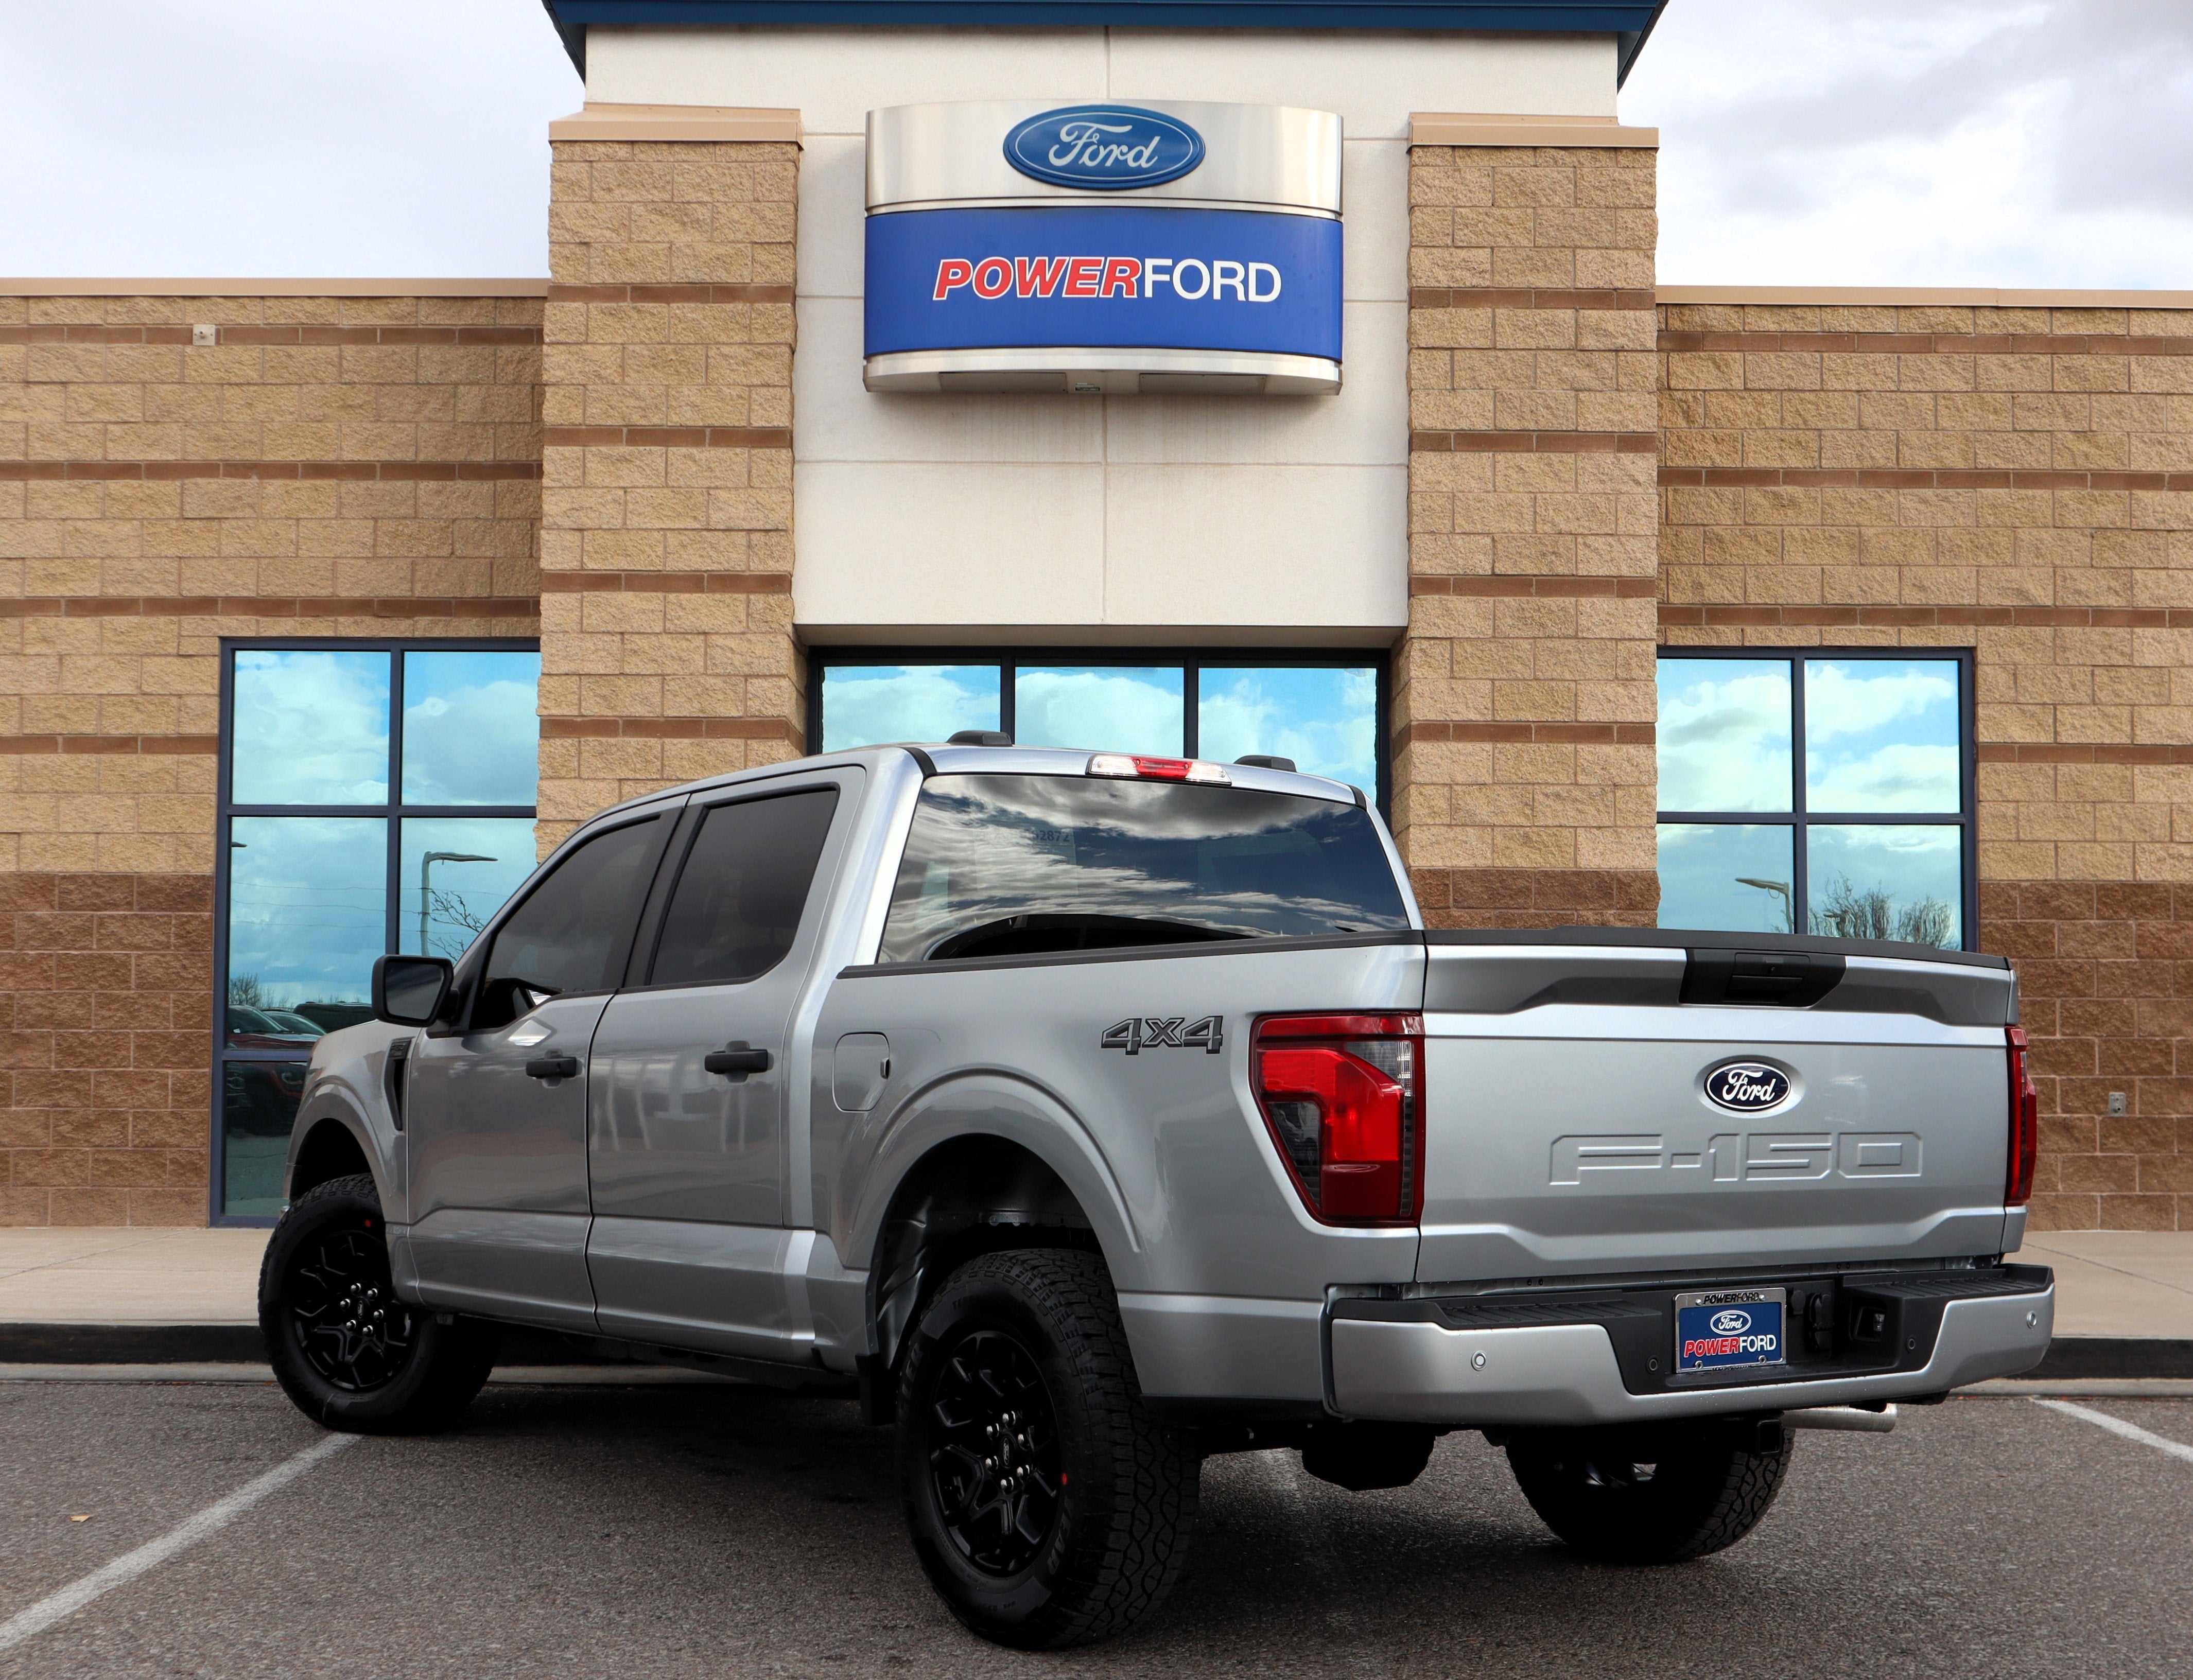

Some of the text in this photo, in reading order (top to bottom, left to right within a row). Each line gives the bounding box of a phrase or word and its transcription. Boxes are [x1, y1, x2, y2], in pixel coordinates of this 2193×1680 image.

[1049, 122, 1161, 168] Ford
[933, 256, 1282, 302] POWERFORD
[1722, 1070, 1776, 1101] Ford
[1549, 1132, 1923, 1185] F-150
[1703, 1292, 1759, 1305] POWERFORD
[1718, 1315, 1743, 1329] Ford
[1684, 1335, 1776, 1358] POWERFORD
